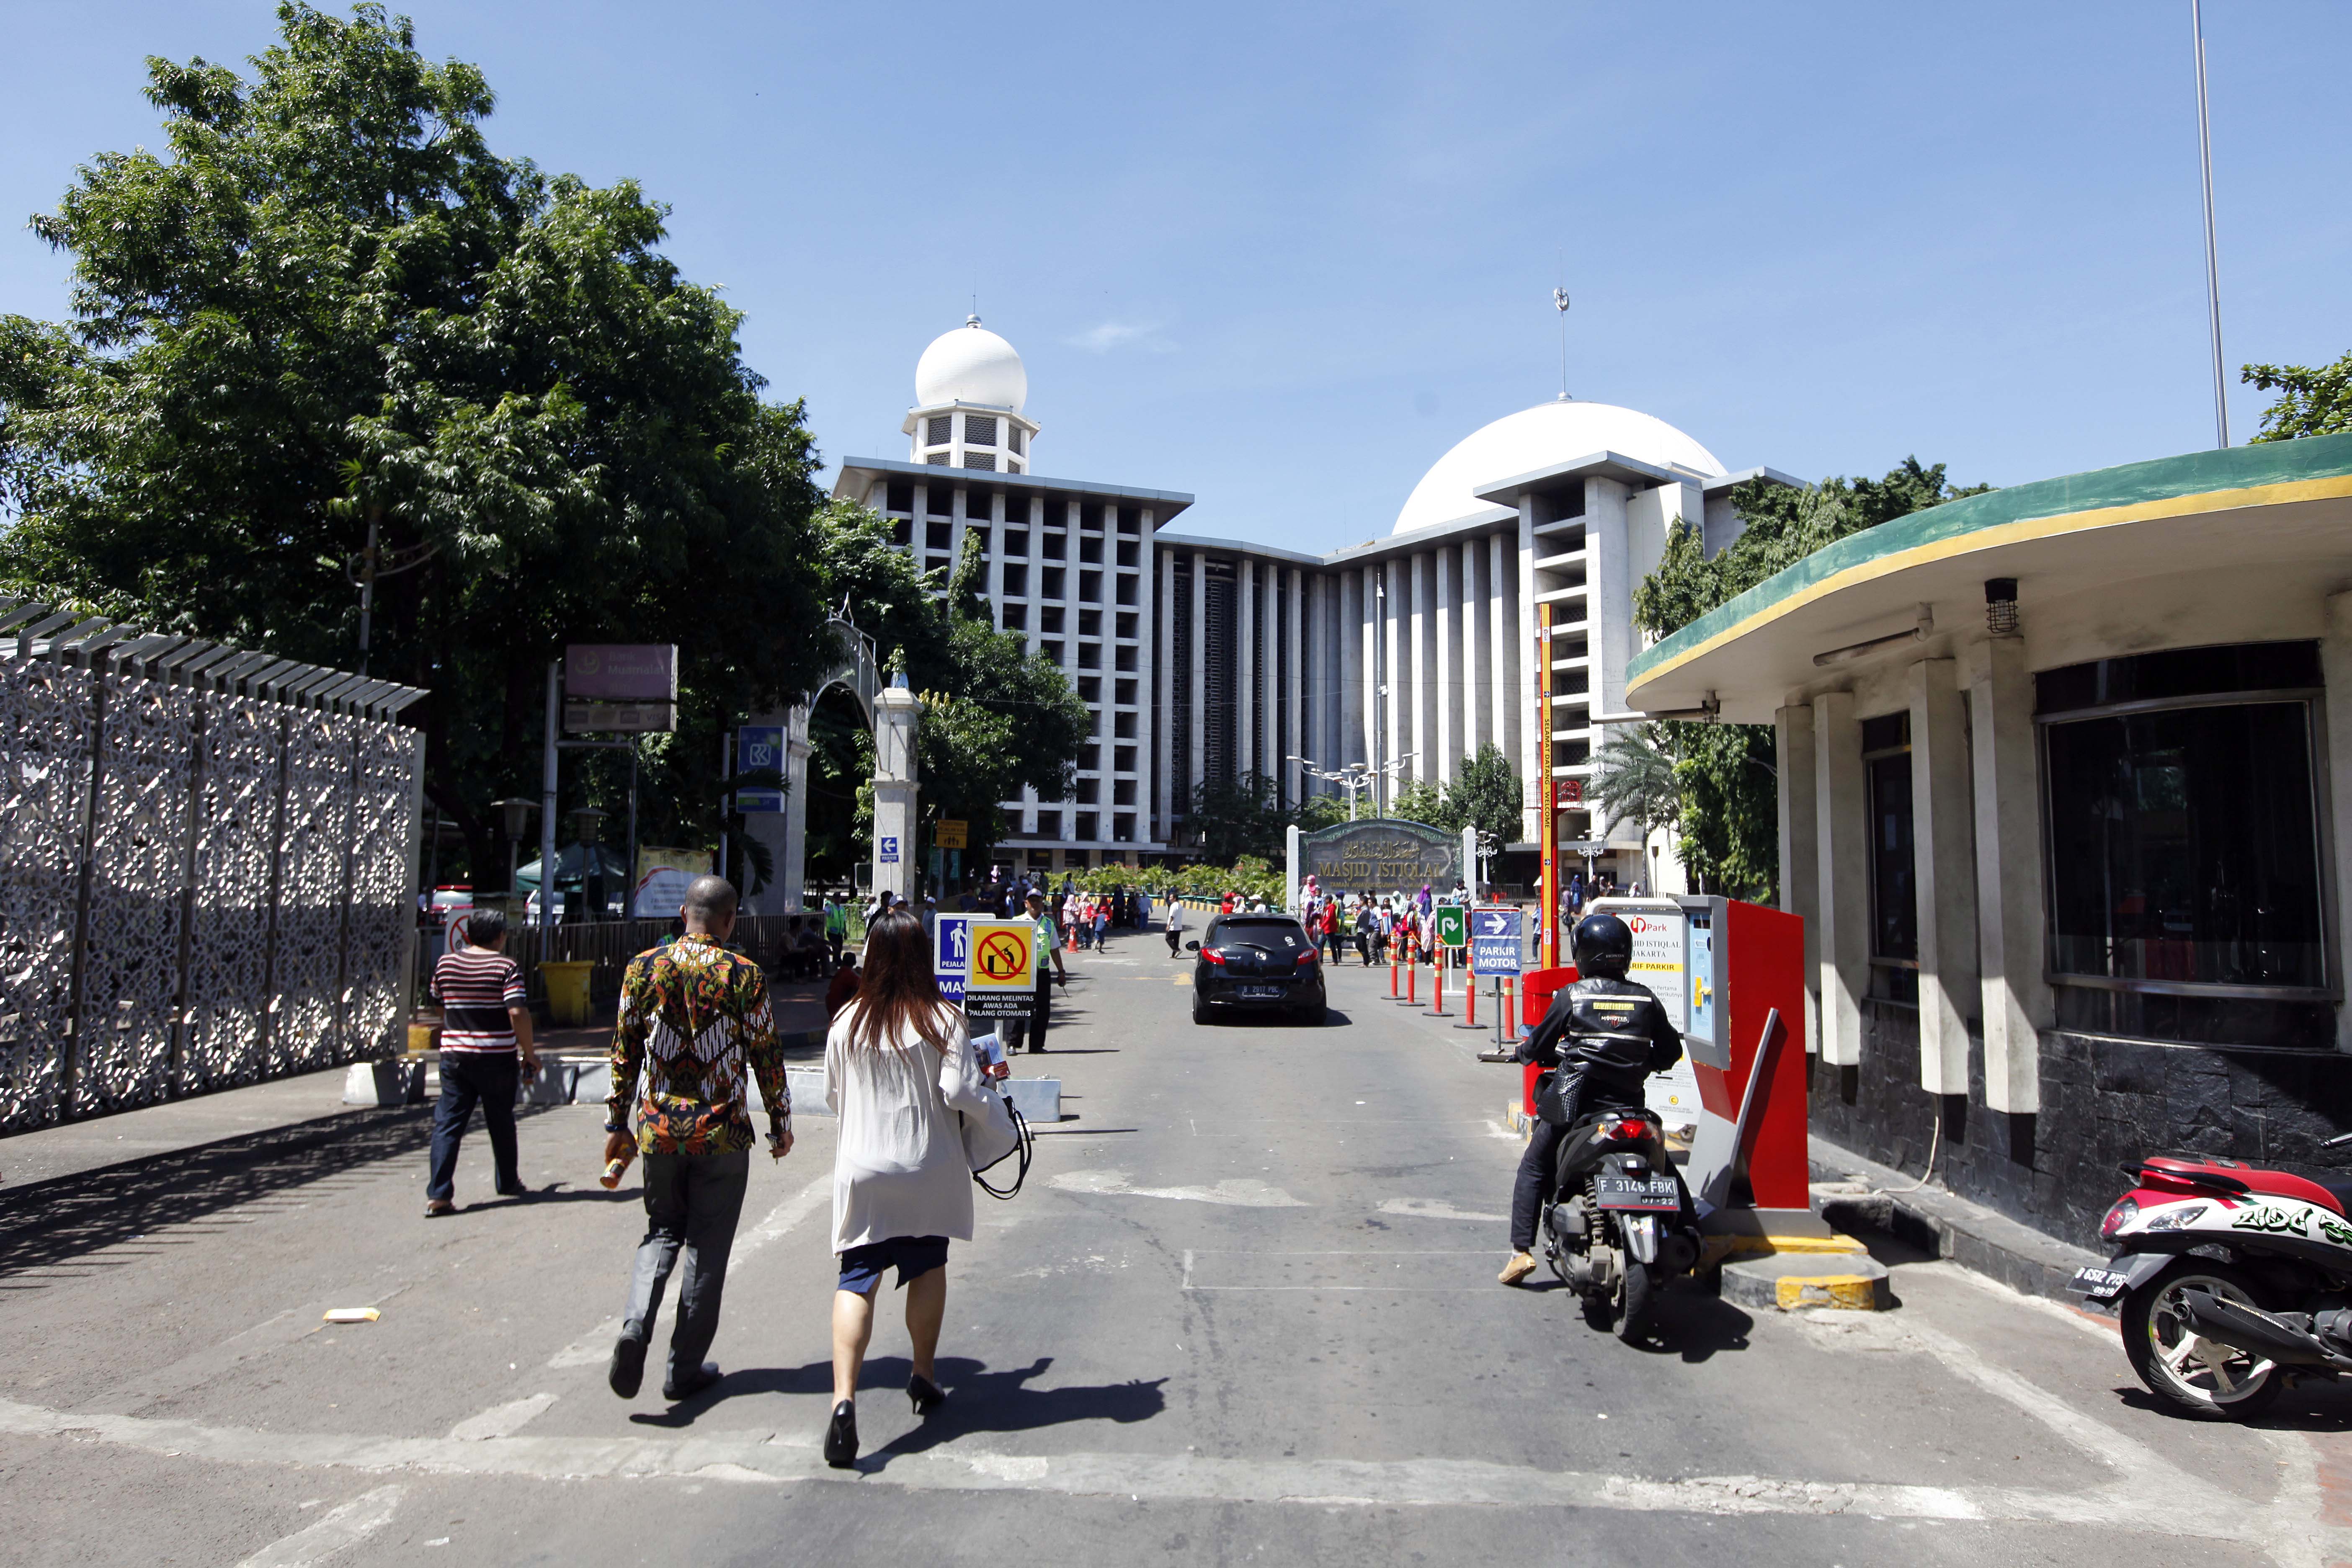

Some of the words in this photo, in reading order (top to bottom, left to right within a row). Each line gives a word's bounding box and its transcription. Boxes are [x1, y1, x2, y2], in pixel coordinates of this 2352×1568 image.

[1318, 862, 1371, 881] MASJID
[1377, 862, 1445, 880] ISTIQLAL
[1480, 946, 1515, 956] PARKIR
[1479, 958, 1517, 967] MOTOR
[1600, 1180, 1607, 1191] F
[1616, 1180, 1646, 1193] 3146
[1650, 1180, 1673, 1194] FBK
[2075, 1267, 2086, 1279] B
[2083, 1268, 2107, 1283] 6512
[2261, 1315, 2285, 1329] CRIME
